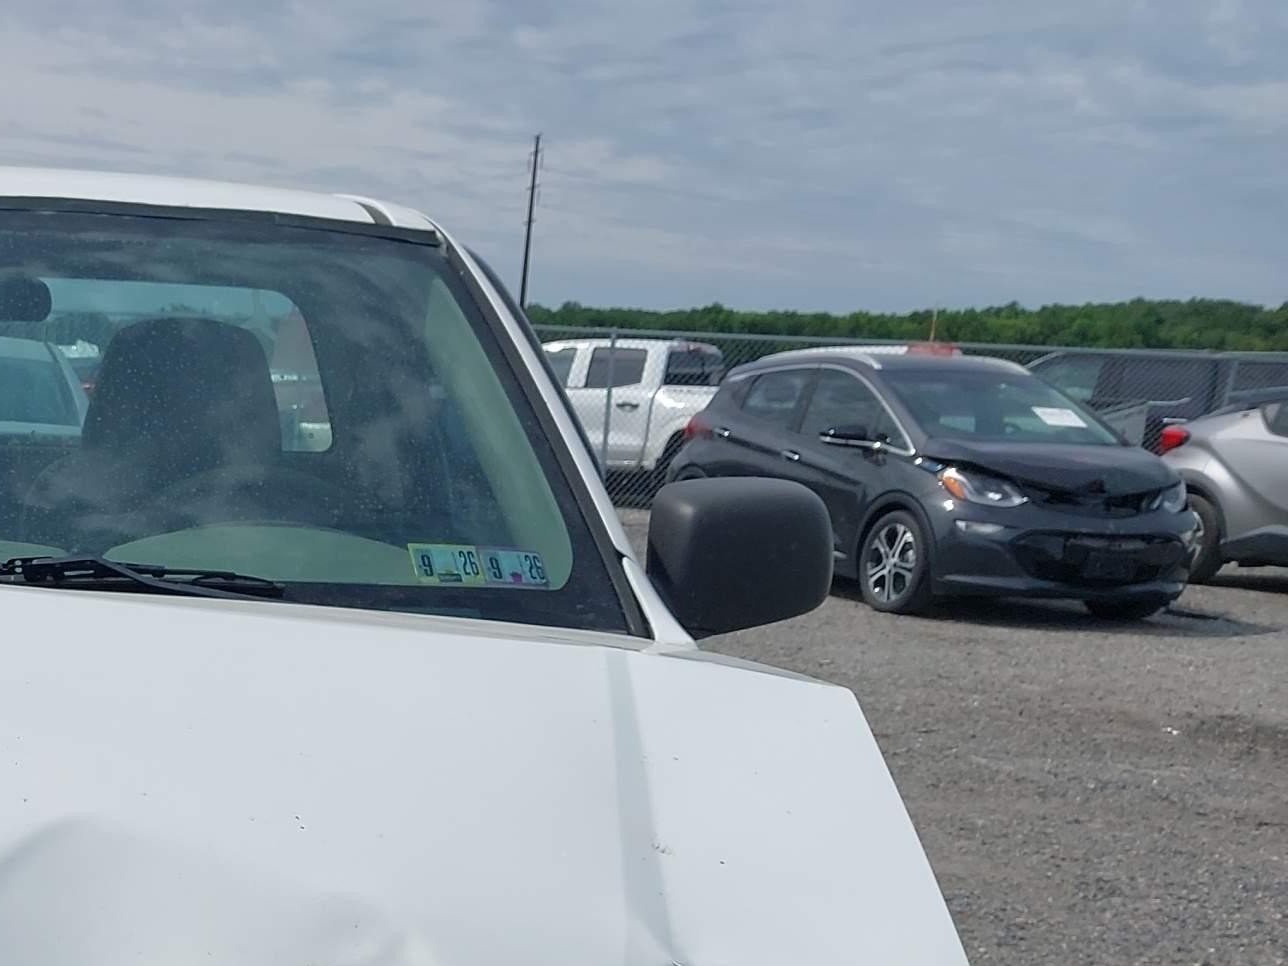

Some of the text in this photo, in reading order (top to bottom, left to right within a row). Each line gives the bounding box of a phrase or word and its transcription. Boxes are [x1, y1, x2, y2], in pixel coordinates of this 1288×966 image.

[420, 550, 480, 577] 9 26
[489, 554, 546, 580] 9 26
